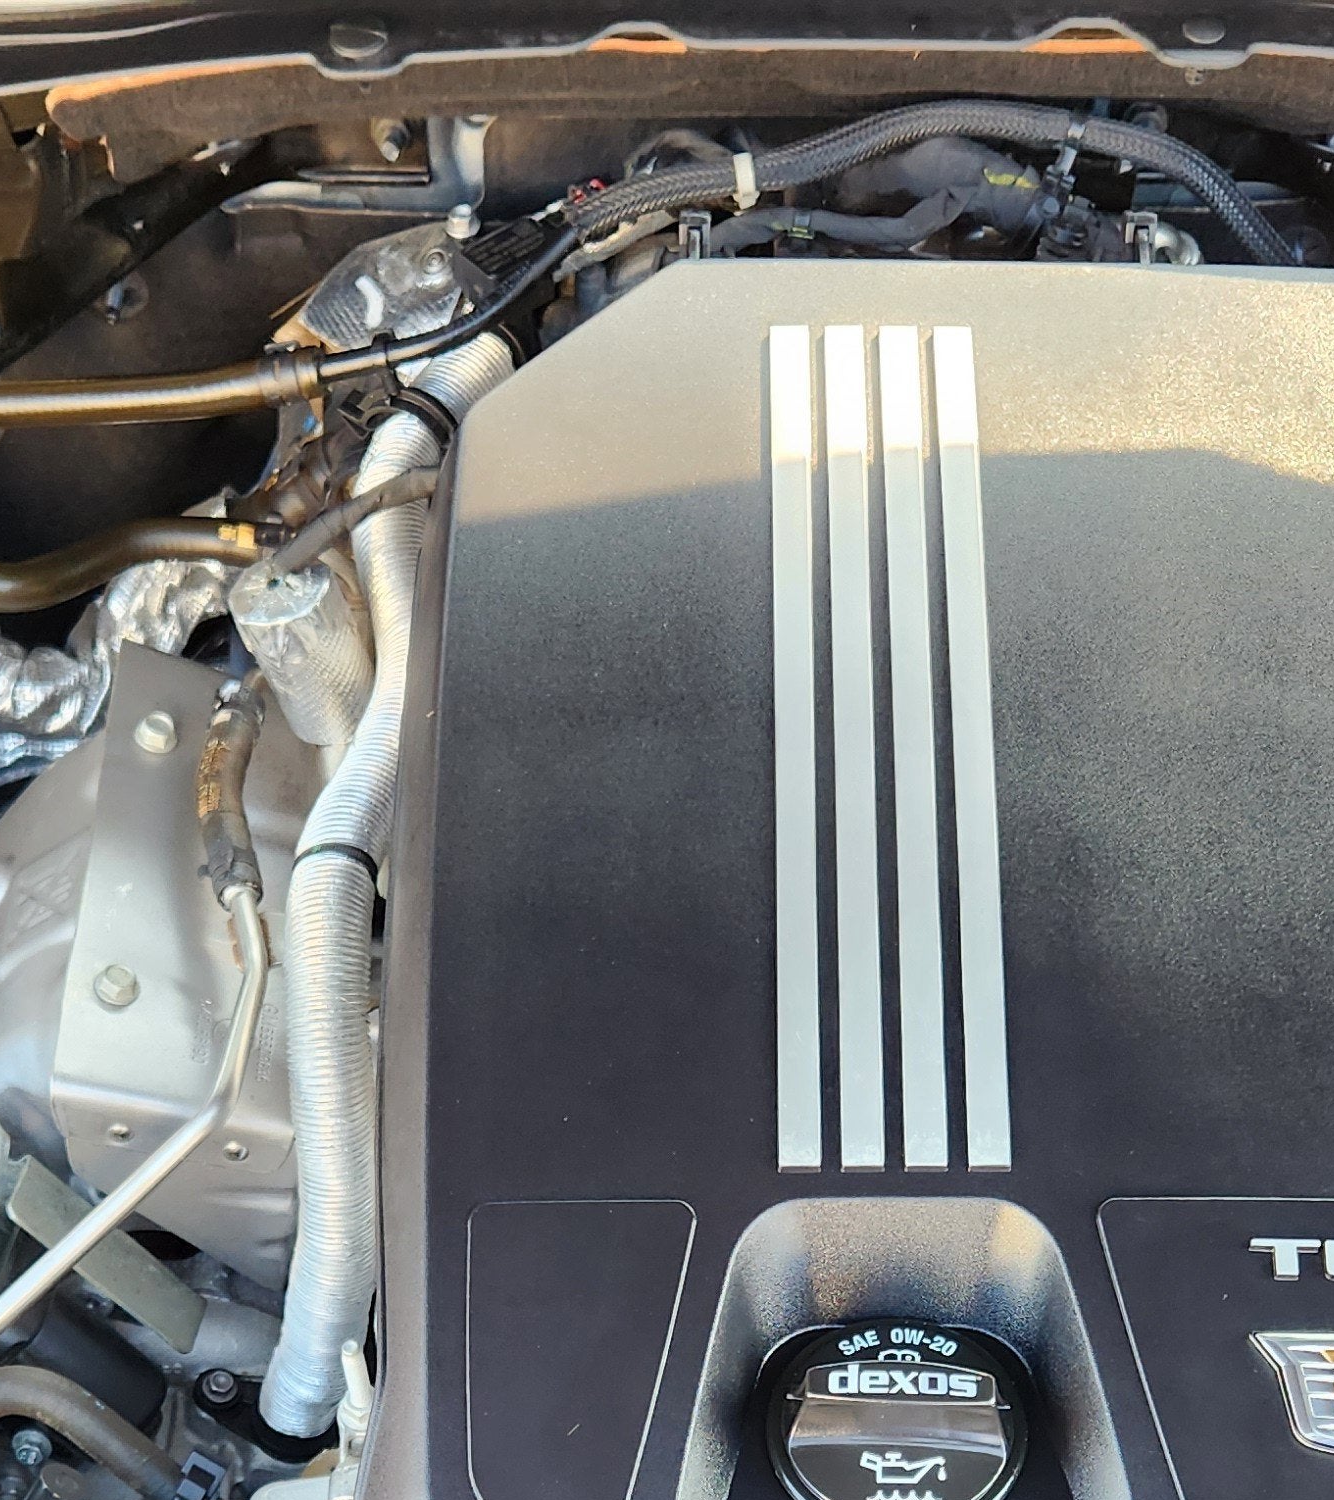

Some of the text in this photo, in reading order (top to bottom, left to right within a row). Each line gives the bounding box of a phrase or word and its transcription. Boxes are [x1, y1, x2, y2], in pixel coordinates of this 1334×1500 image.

[838, 1327, 960, 1357] SAE 0W-20
[828, 1364, 980, 1399] dexos
